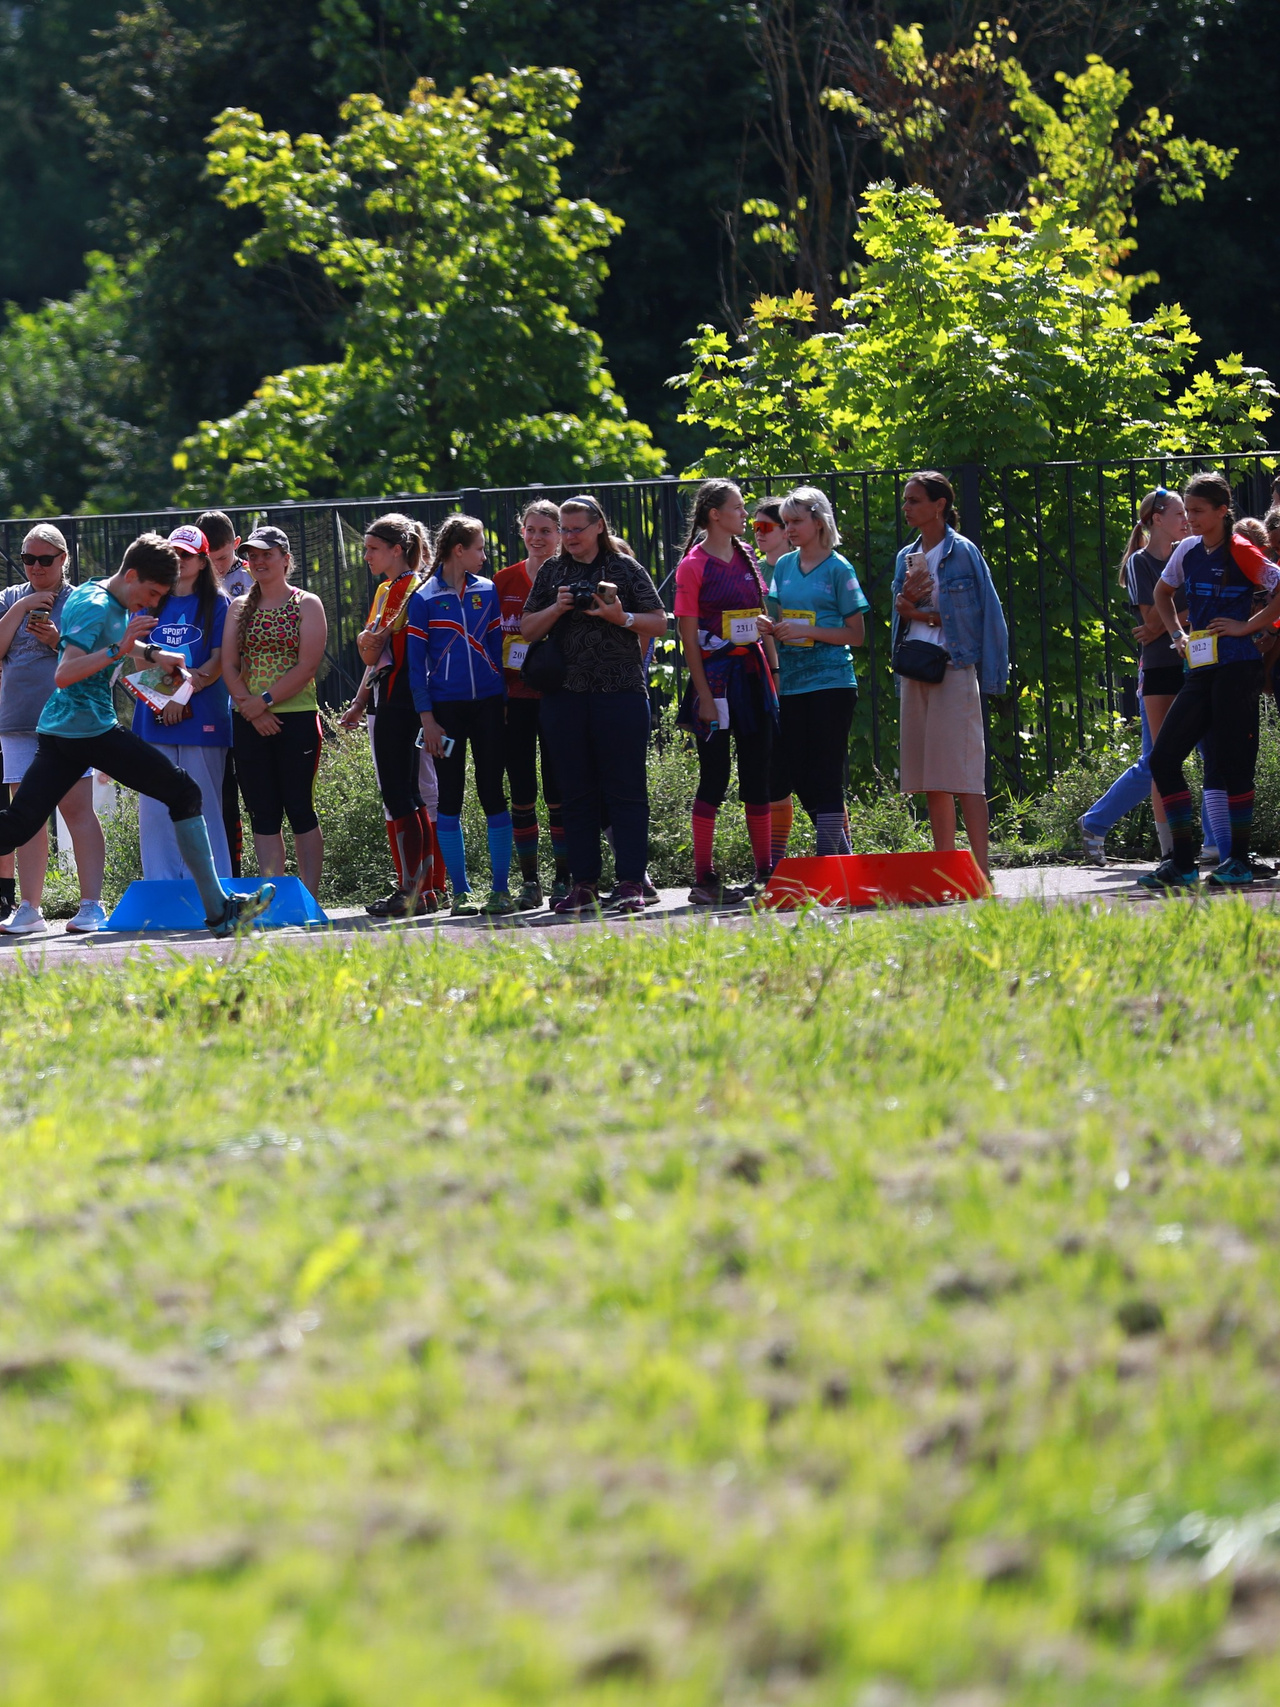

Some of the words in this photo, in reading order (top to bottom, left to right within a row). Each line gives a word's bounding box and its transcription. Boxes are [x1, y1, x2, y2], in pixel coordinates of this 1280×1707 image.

[162, 627, 188, 636] SPORTY
[166, 636, 182, 645] BABY
[1192, 642, 1207, 653] 202.2
